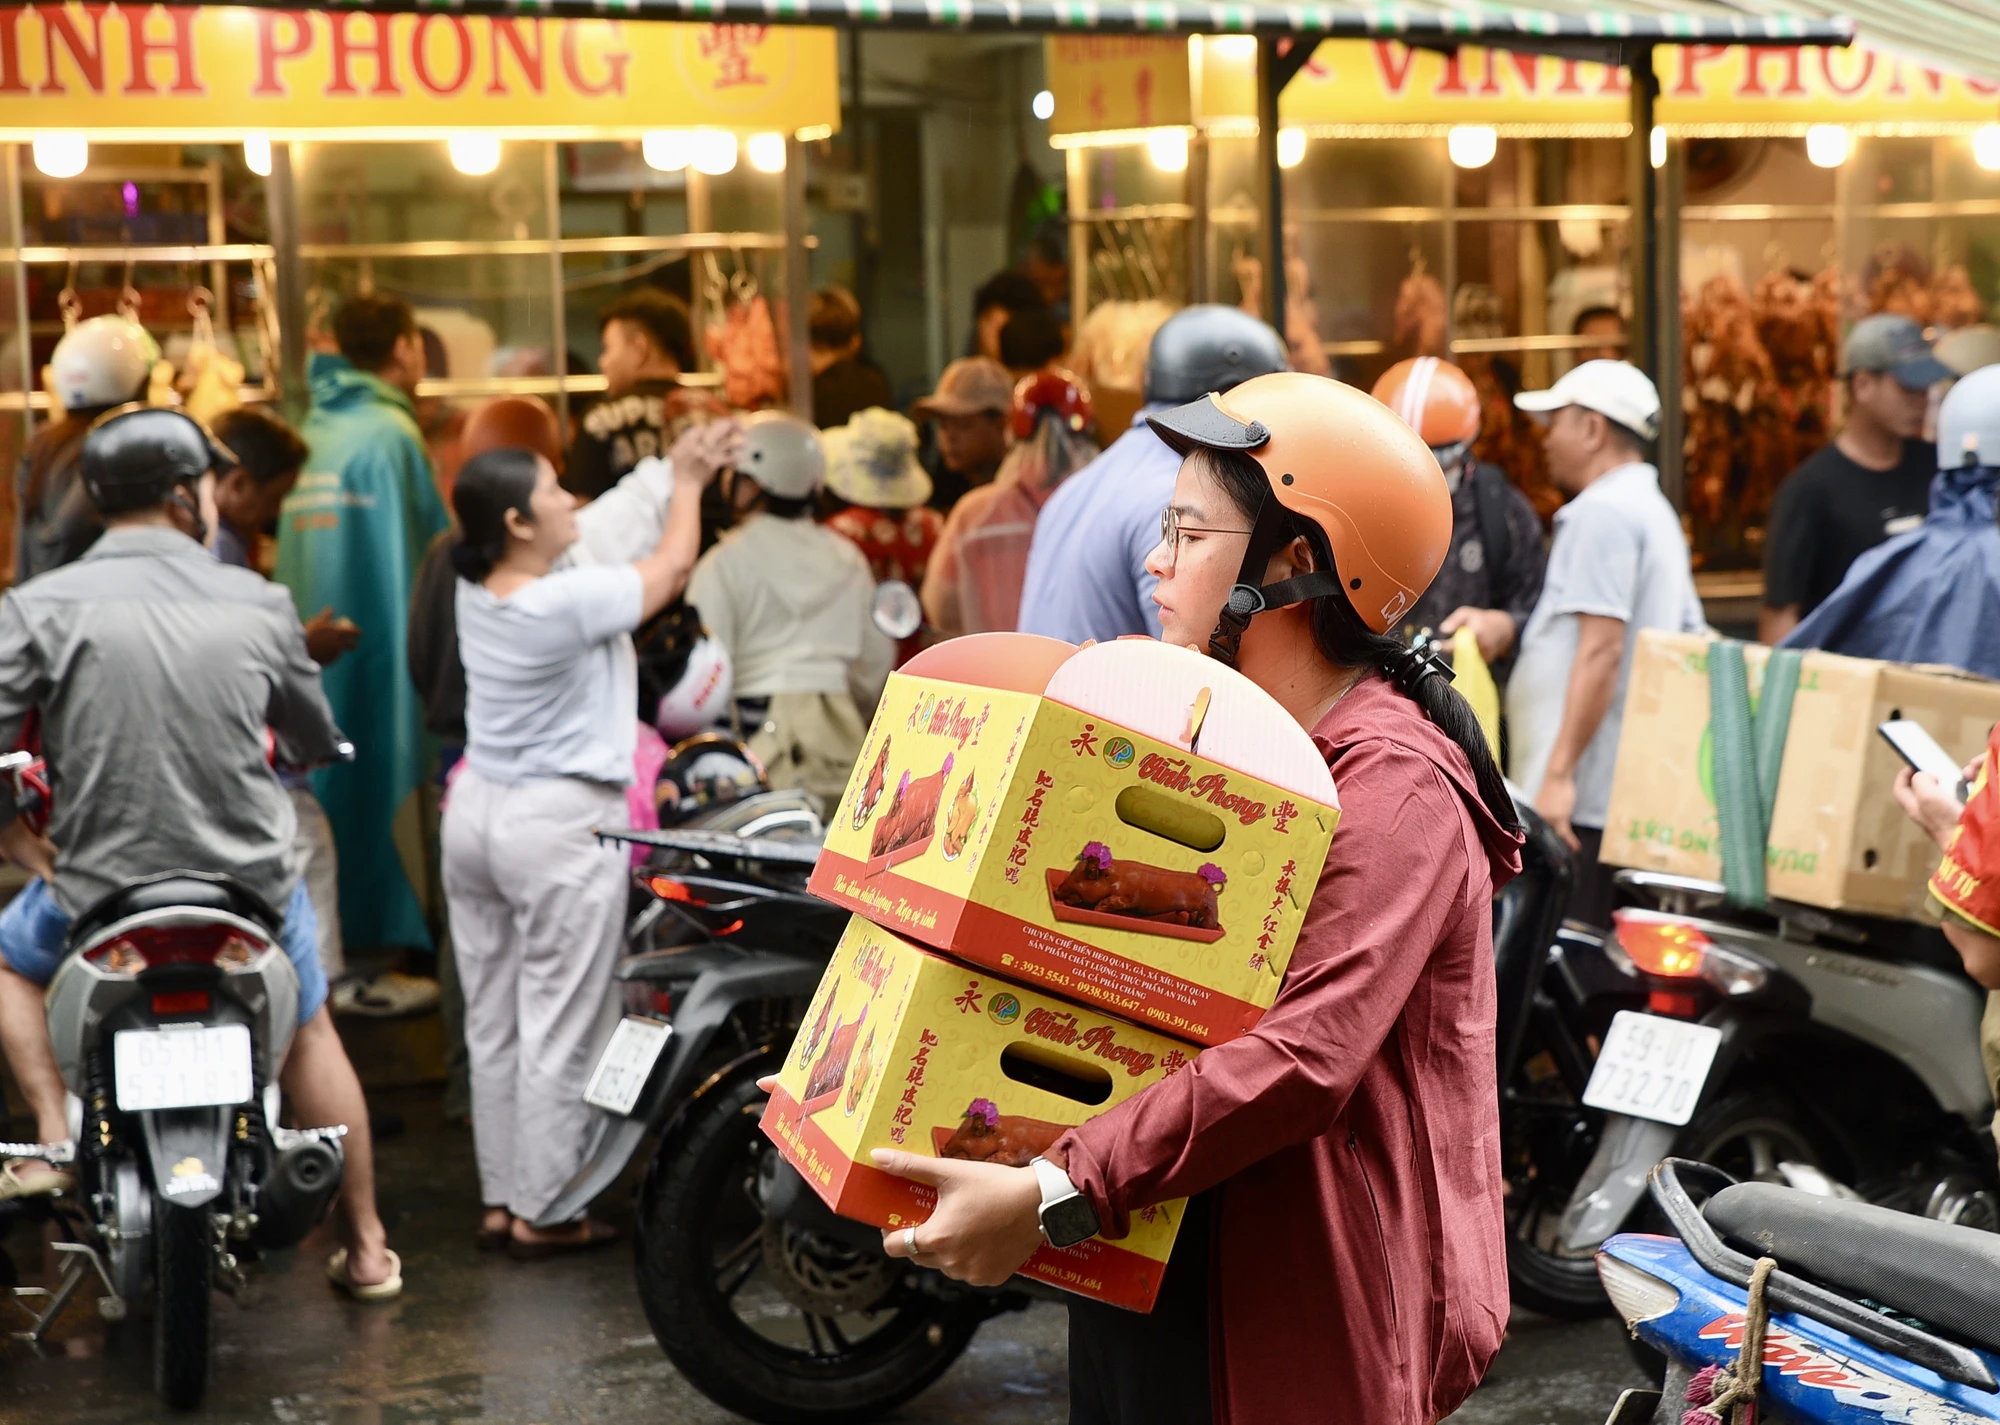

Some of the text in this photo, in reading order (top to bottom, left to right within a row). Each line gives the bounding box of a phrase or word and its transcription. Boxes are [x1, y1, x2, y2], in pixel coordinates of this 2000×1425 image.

[251, 12, 630, 97] PHONG
[1670, 44, 2000, 97] PHON
[1070, 724, 1099, 757] 永
[1138, 752, 1267, 825] Vĩnh Phong
[1022, 925, 1055, 942] CHUYÊN
[1055, 938, 1074, 949] CHẾ
[1072, 943, 1092, 956] BIẾN
[1091, 951, 1109, 963] HEO
[1189, 986, 1212, 1000] QUAY
[1068, 954, 1091, 967] CHẤT
[1120, 972, 1142, 986] THỰC
[1164, 990, 1177, 999] AN
[1176, 993, 1198, 1007] TOÀN
[1072, 967, 1087, 978] GIÁ
[955, 981, 983, 1014] 永
[1019, 960, 1209, 1037] 3923 5543 0938.933.647 0903.391.684
[1024, 1007, 1155, 1077] Vĩnh Phong
[909, 1185, 937, 1199] CHUYÊ
[1038, 1262, 1102, 1291] 0903.391.684
